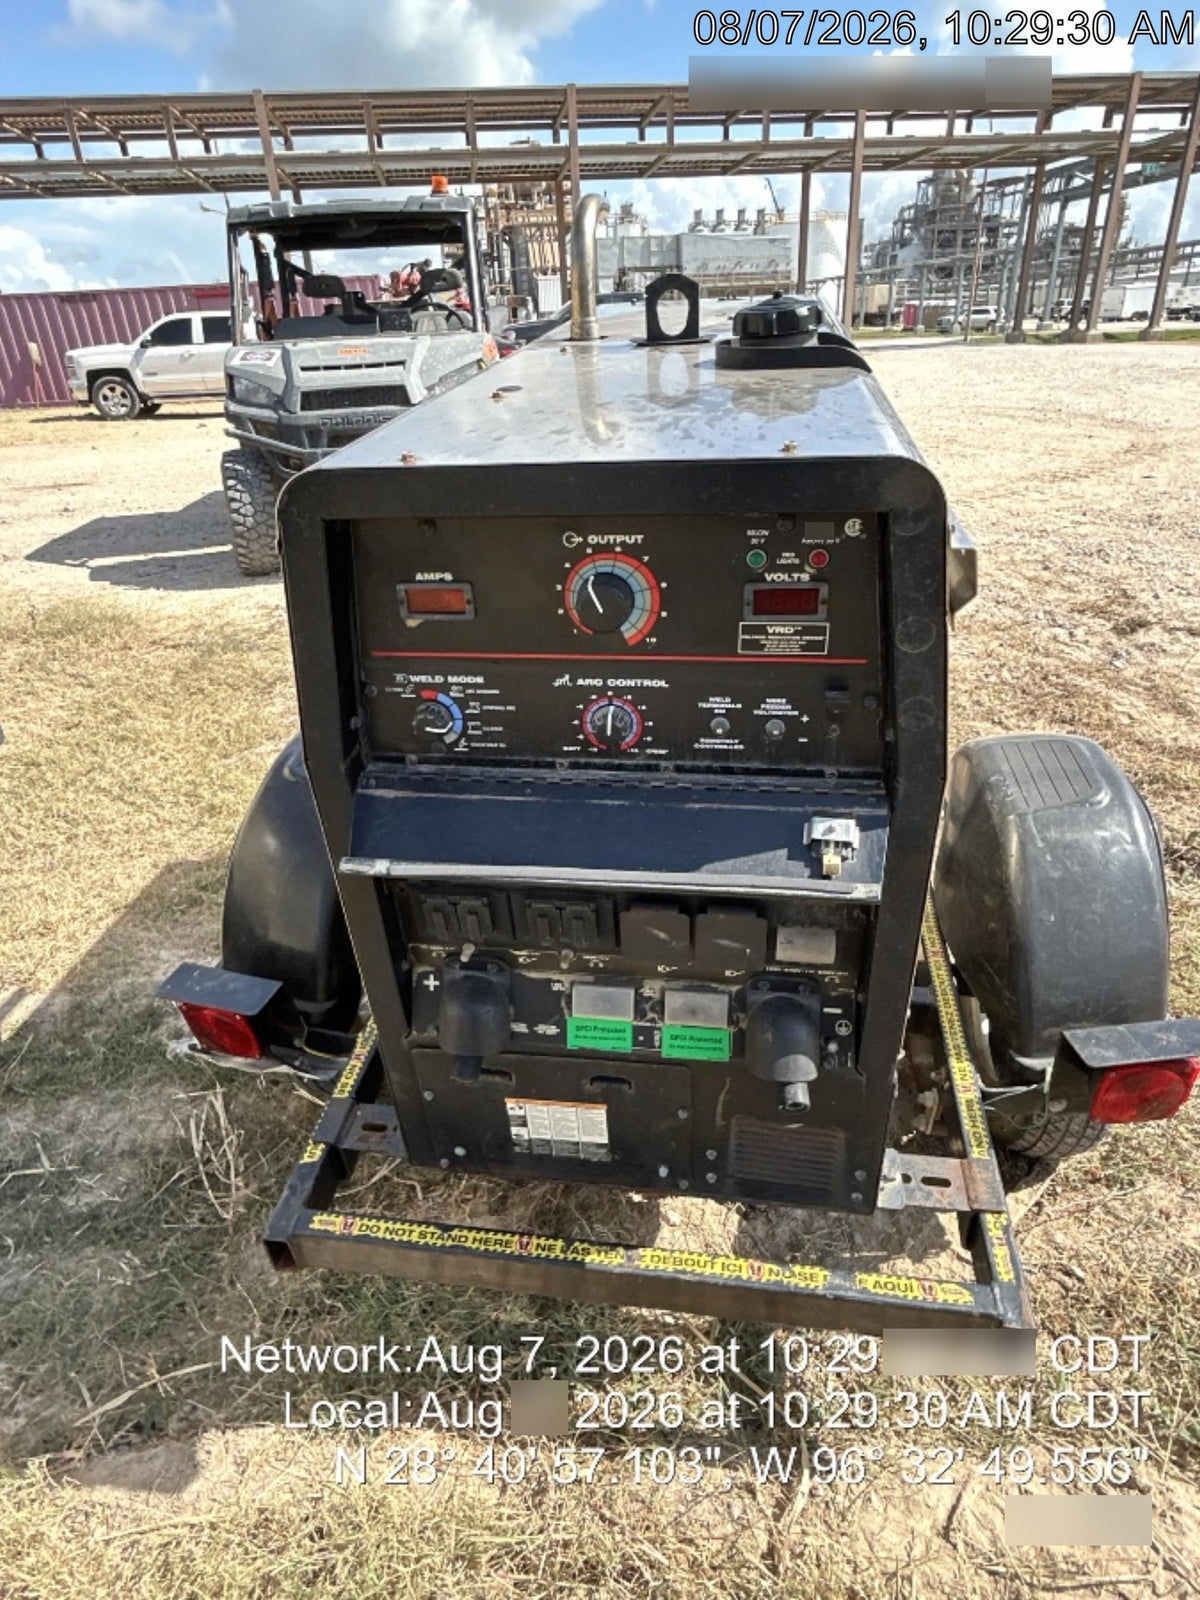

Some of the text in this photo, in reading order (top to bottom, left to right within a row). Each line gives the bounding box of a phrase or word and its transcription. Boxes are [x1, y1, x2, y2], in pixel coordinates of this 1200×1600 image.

[587, 534, 644, 545] OUTPUT
[415, 571, 454, 582] AMPS
[764, 572, 811, 582] VOLTS
[409, 675, 485, 684] WELD MODE
[576, 678, 670, 688] ARC CONTROL
[966, 1097, 981, 1129] HERE
[357, 1222, 382, 1234] DO
[384, 1225, 416, 1239] NOT
[417, 1229, 469, 1245] STAND
[471, 1236, 514, 1249] HERE
[535, 1241, 558, 1253] NE
[721, 1261, 743, 1274] ICI
